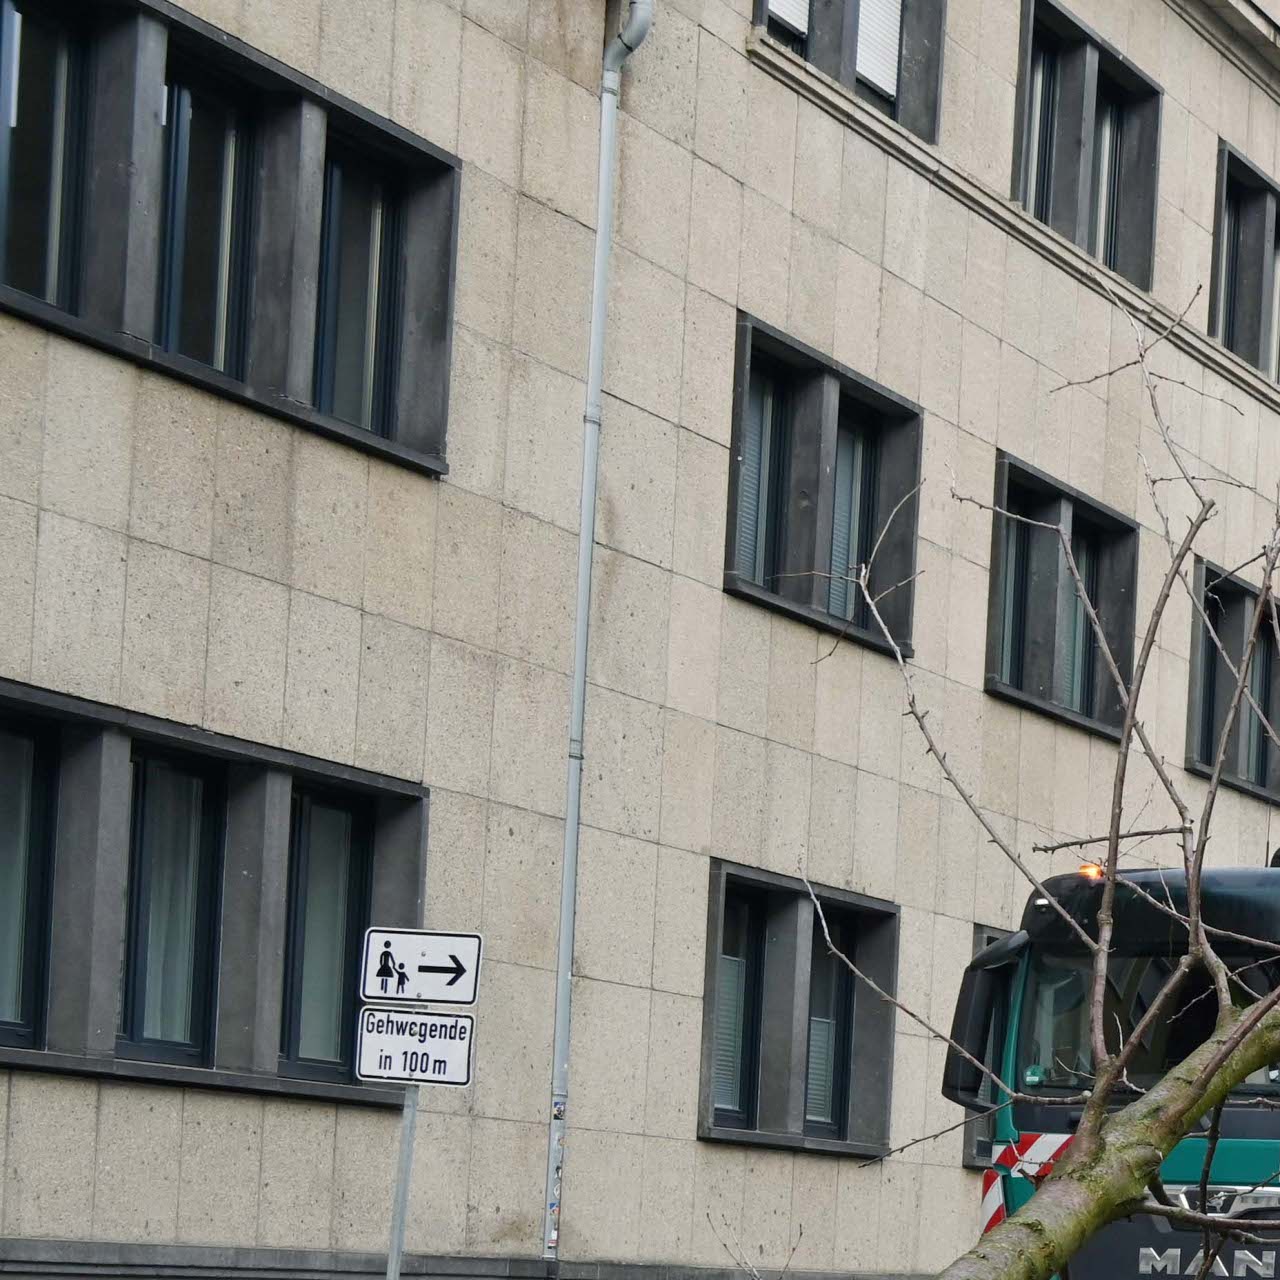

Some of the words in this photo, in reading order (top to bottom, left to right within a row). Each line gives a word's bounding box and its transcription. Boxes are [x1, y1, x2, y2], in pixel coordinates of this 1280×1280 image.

[366, 1012, 467, 1044] Gehwegende
[378, 1048, 392, 1071] in
[1138, 1247, 1277, 1279] MAN
